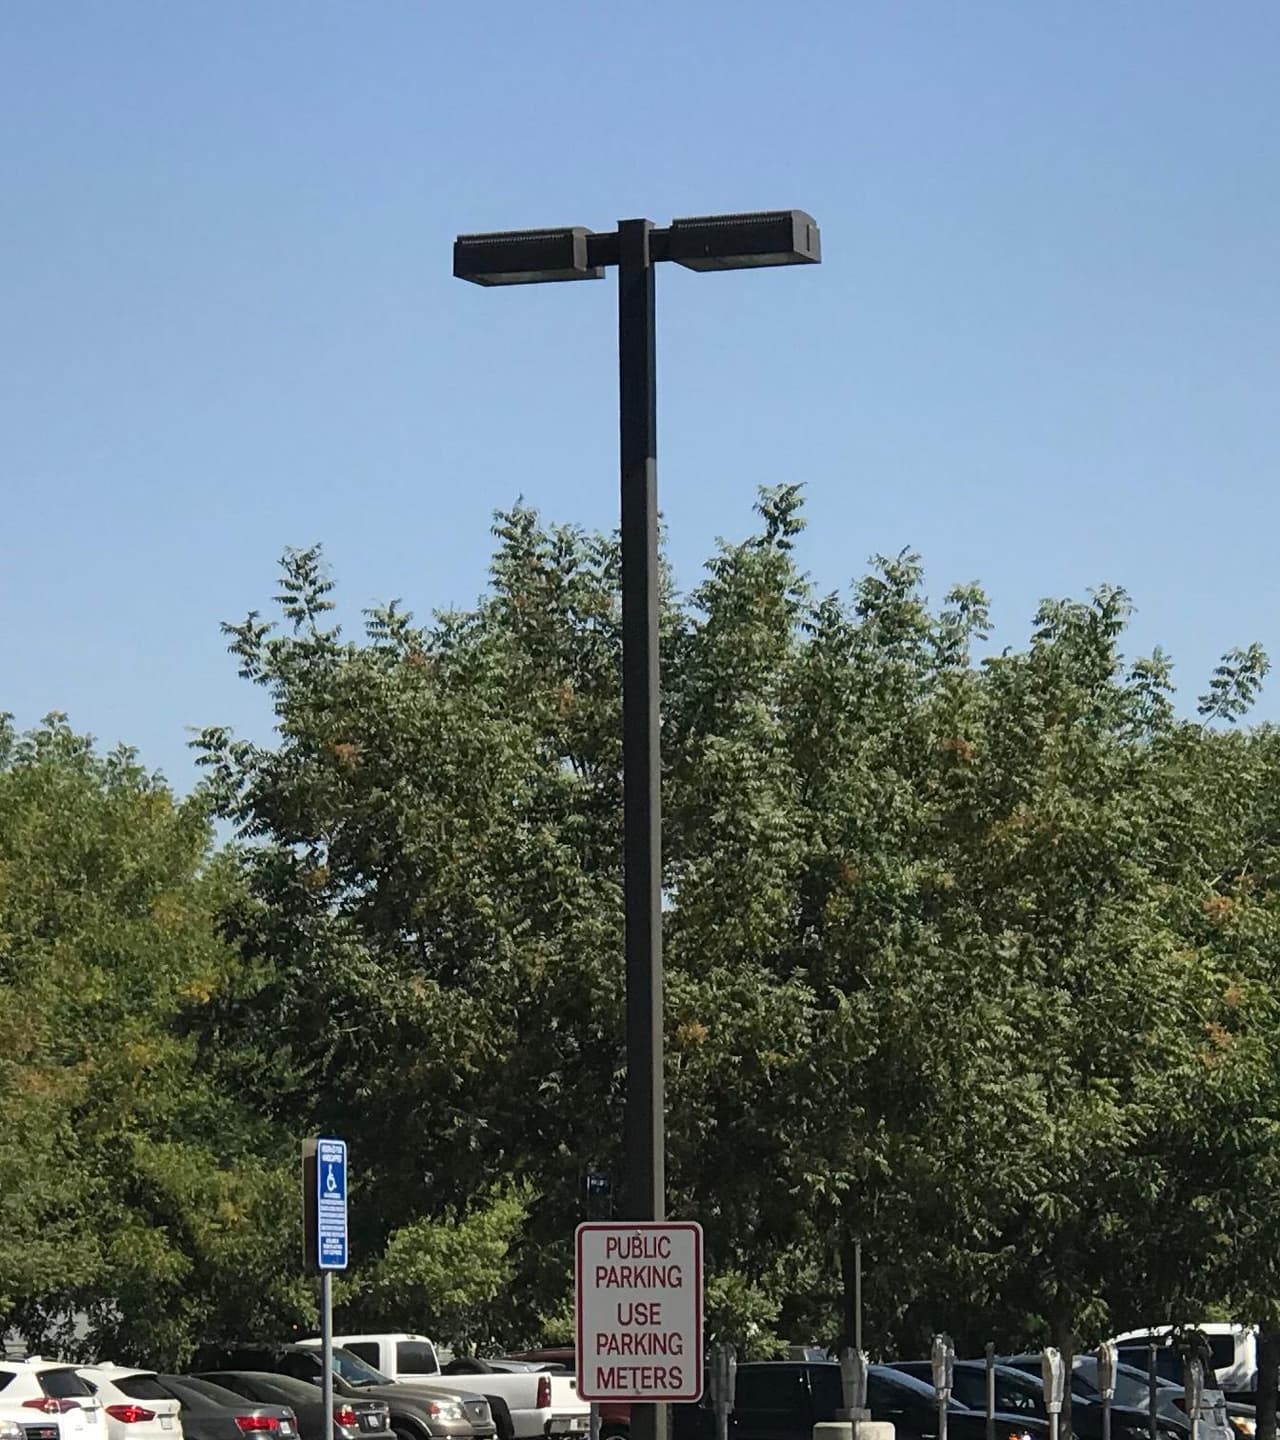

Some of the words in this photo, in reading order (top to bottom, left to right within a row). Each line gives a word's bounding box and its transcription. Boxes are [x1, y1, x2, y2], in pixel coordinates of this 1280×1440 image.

[606, 1235, 672, 1259] PUBLIC
[595, 1265, 683, 1289] PARKING
[617, 1302, 662, 1326] USE
[596, 1332, 684, 1356] PARKING
[596, 1366, 684, 1390] METERS
